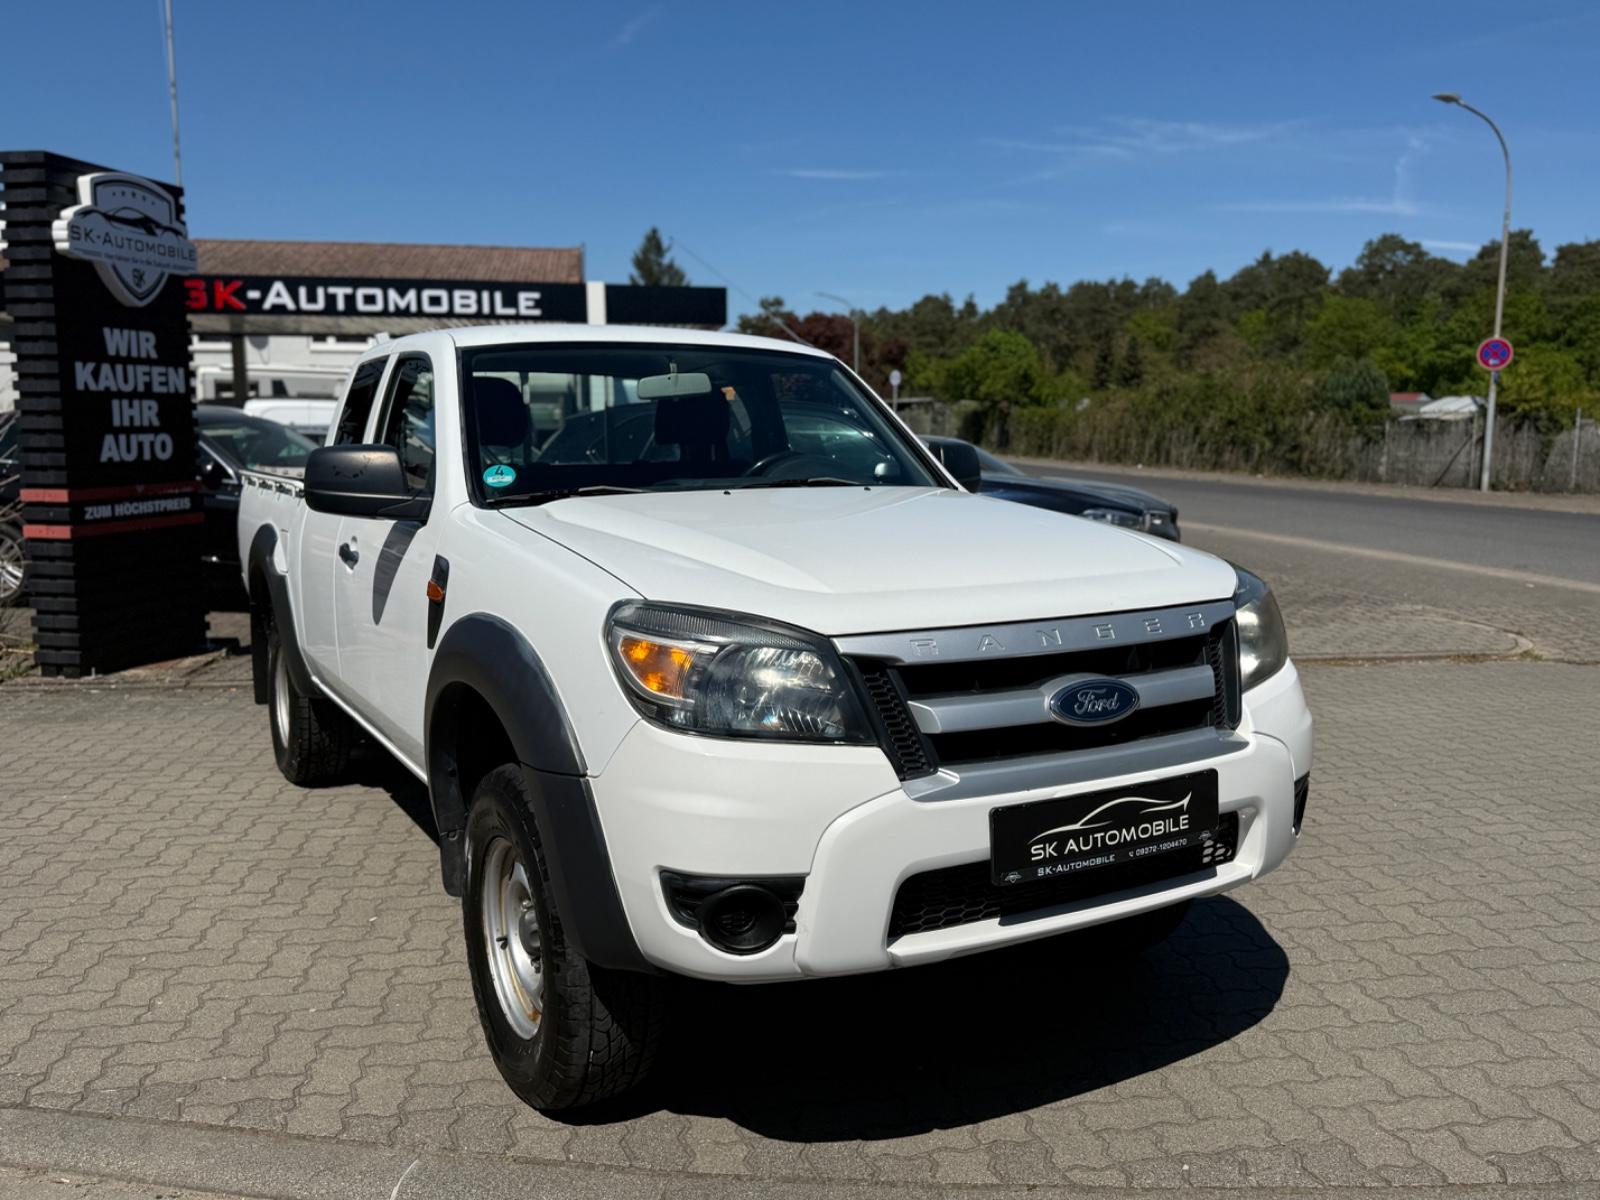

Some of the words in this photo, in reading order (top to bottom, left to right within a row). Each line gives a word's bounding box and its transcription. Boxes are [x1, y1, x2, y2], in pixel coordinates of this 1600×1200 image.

[70, 224, 196, 262] SK-AUTOMOBILE
[103, 327, 158, 359] WIR
[74, 361, 186, 393] KAUFEN
[111, 399, 160, 427] IHR
[100, 433, 173, 462] AUTO
[84, 506, 112, 520] ZUM
[909, 612, 1206, 657] RANGER
[1074, 688, 1119, 715] Ford
[1030, 842, 1058, 861] SK
[1064, 814, 1190, 855] AUTOMOBILE
[1037, 854, 1116, 877] SK-AUTOMOBILE
